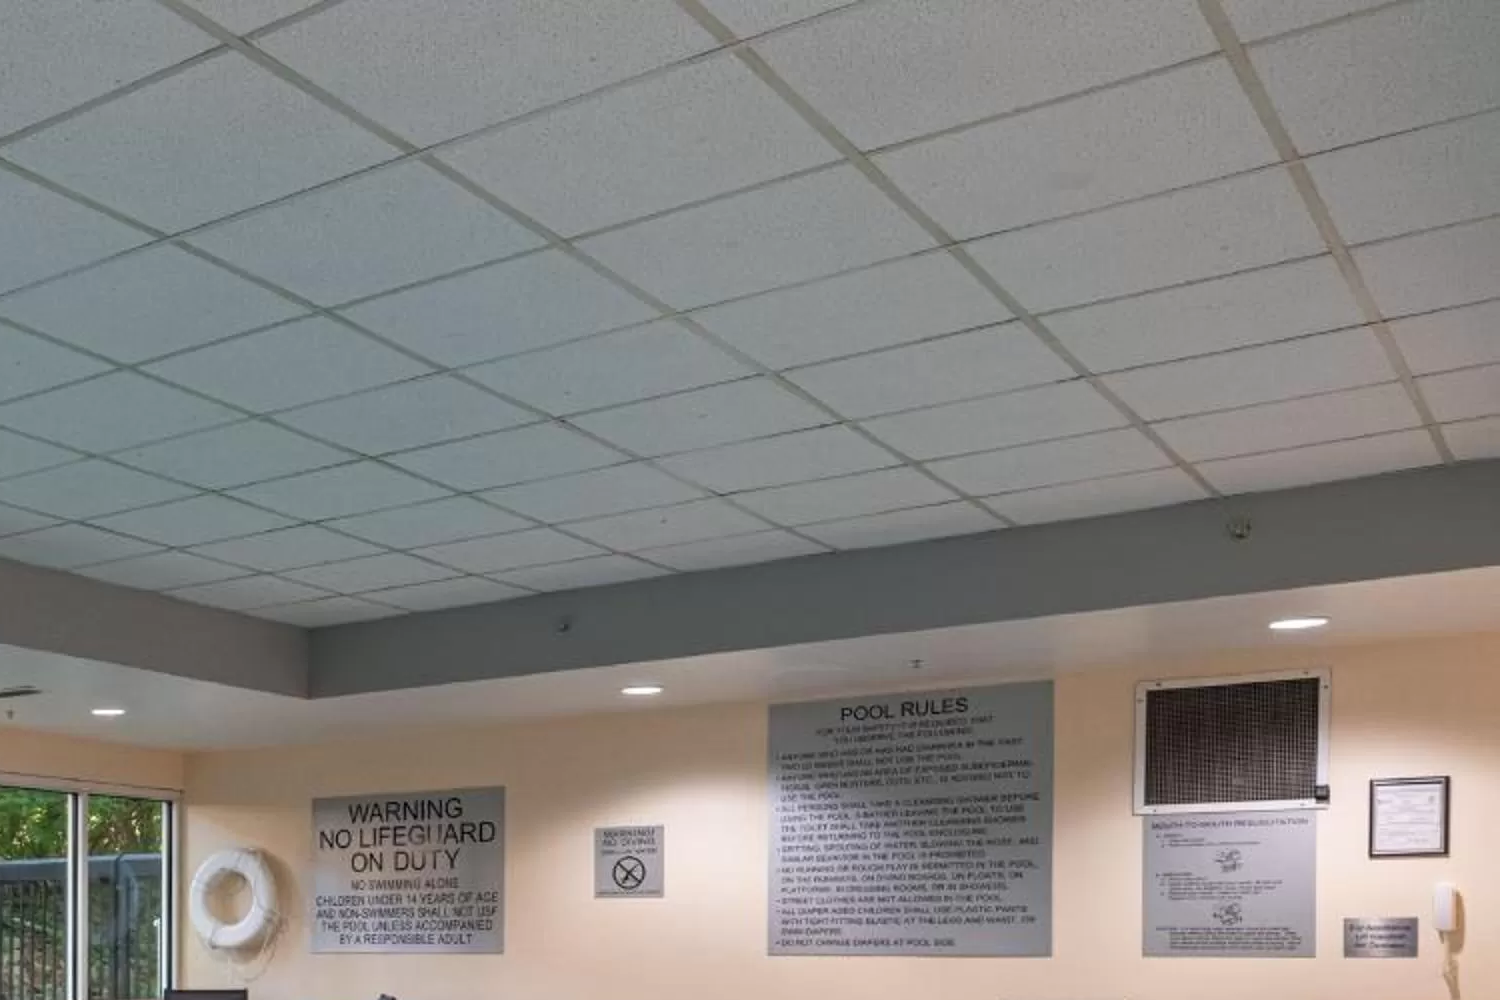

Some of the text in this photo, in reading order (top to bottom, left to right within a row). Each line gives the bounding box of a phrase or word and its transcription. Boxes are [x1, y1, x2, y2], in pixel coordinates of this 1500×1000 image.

[840, 696, 969, 720] POOL RULES
[348, 797, 463, 824] WARNING
[319, 821, 496, 851] NO LIFEGUARD
[351, 848, 460, 873] ON DUTY
[351, 877, 460, 891] NO SWIMMING ALONE
[316, 891, 499, 907] CHILDREN UNDER 14 YEARS OF AGE
[316, 904, 497, 919] AND NON-SWIMMERS SHALL NOT USE
[322, 918, 493, 932] THE POOL UNLESS ACCOMPANIED
[339, 932, 473, 945] BY A RESPONSIBLE ADULT
